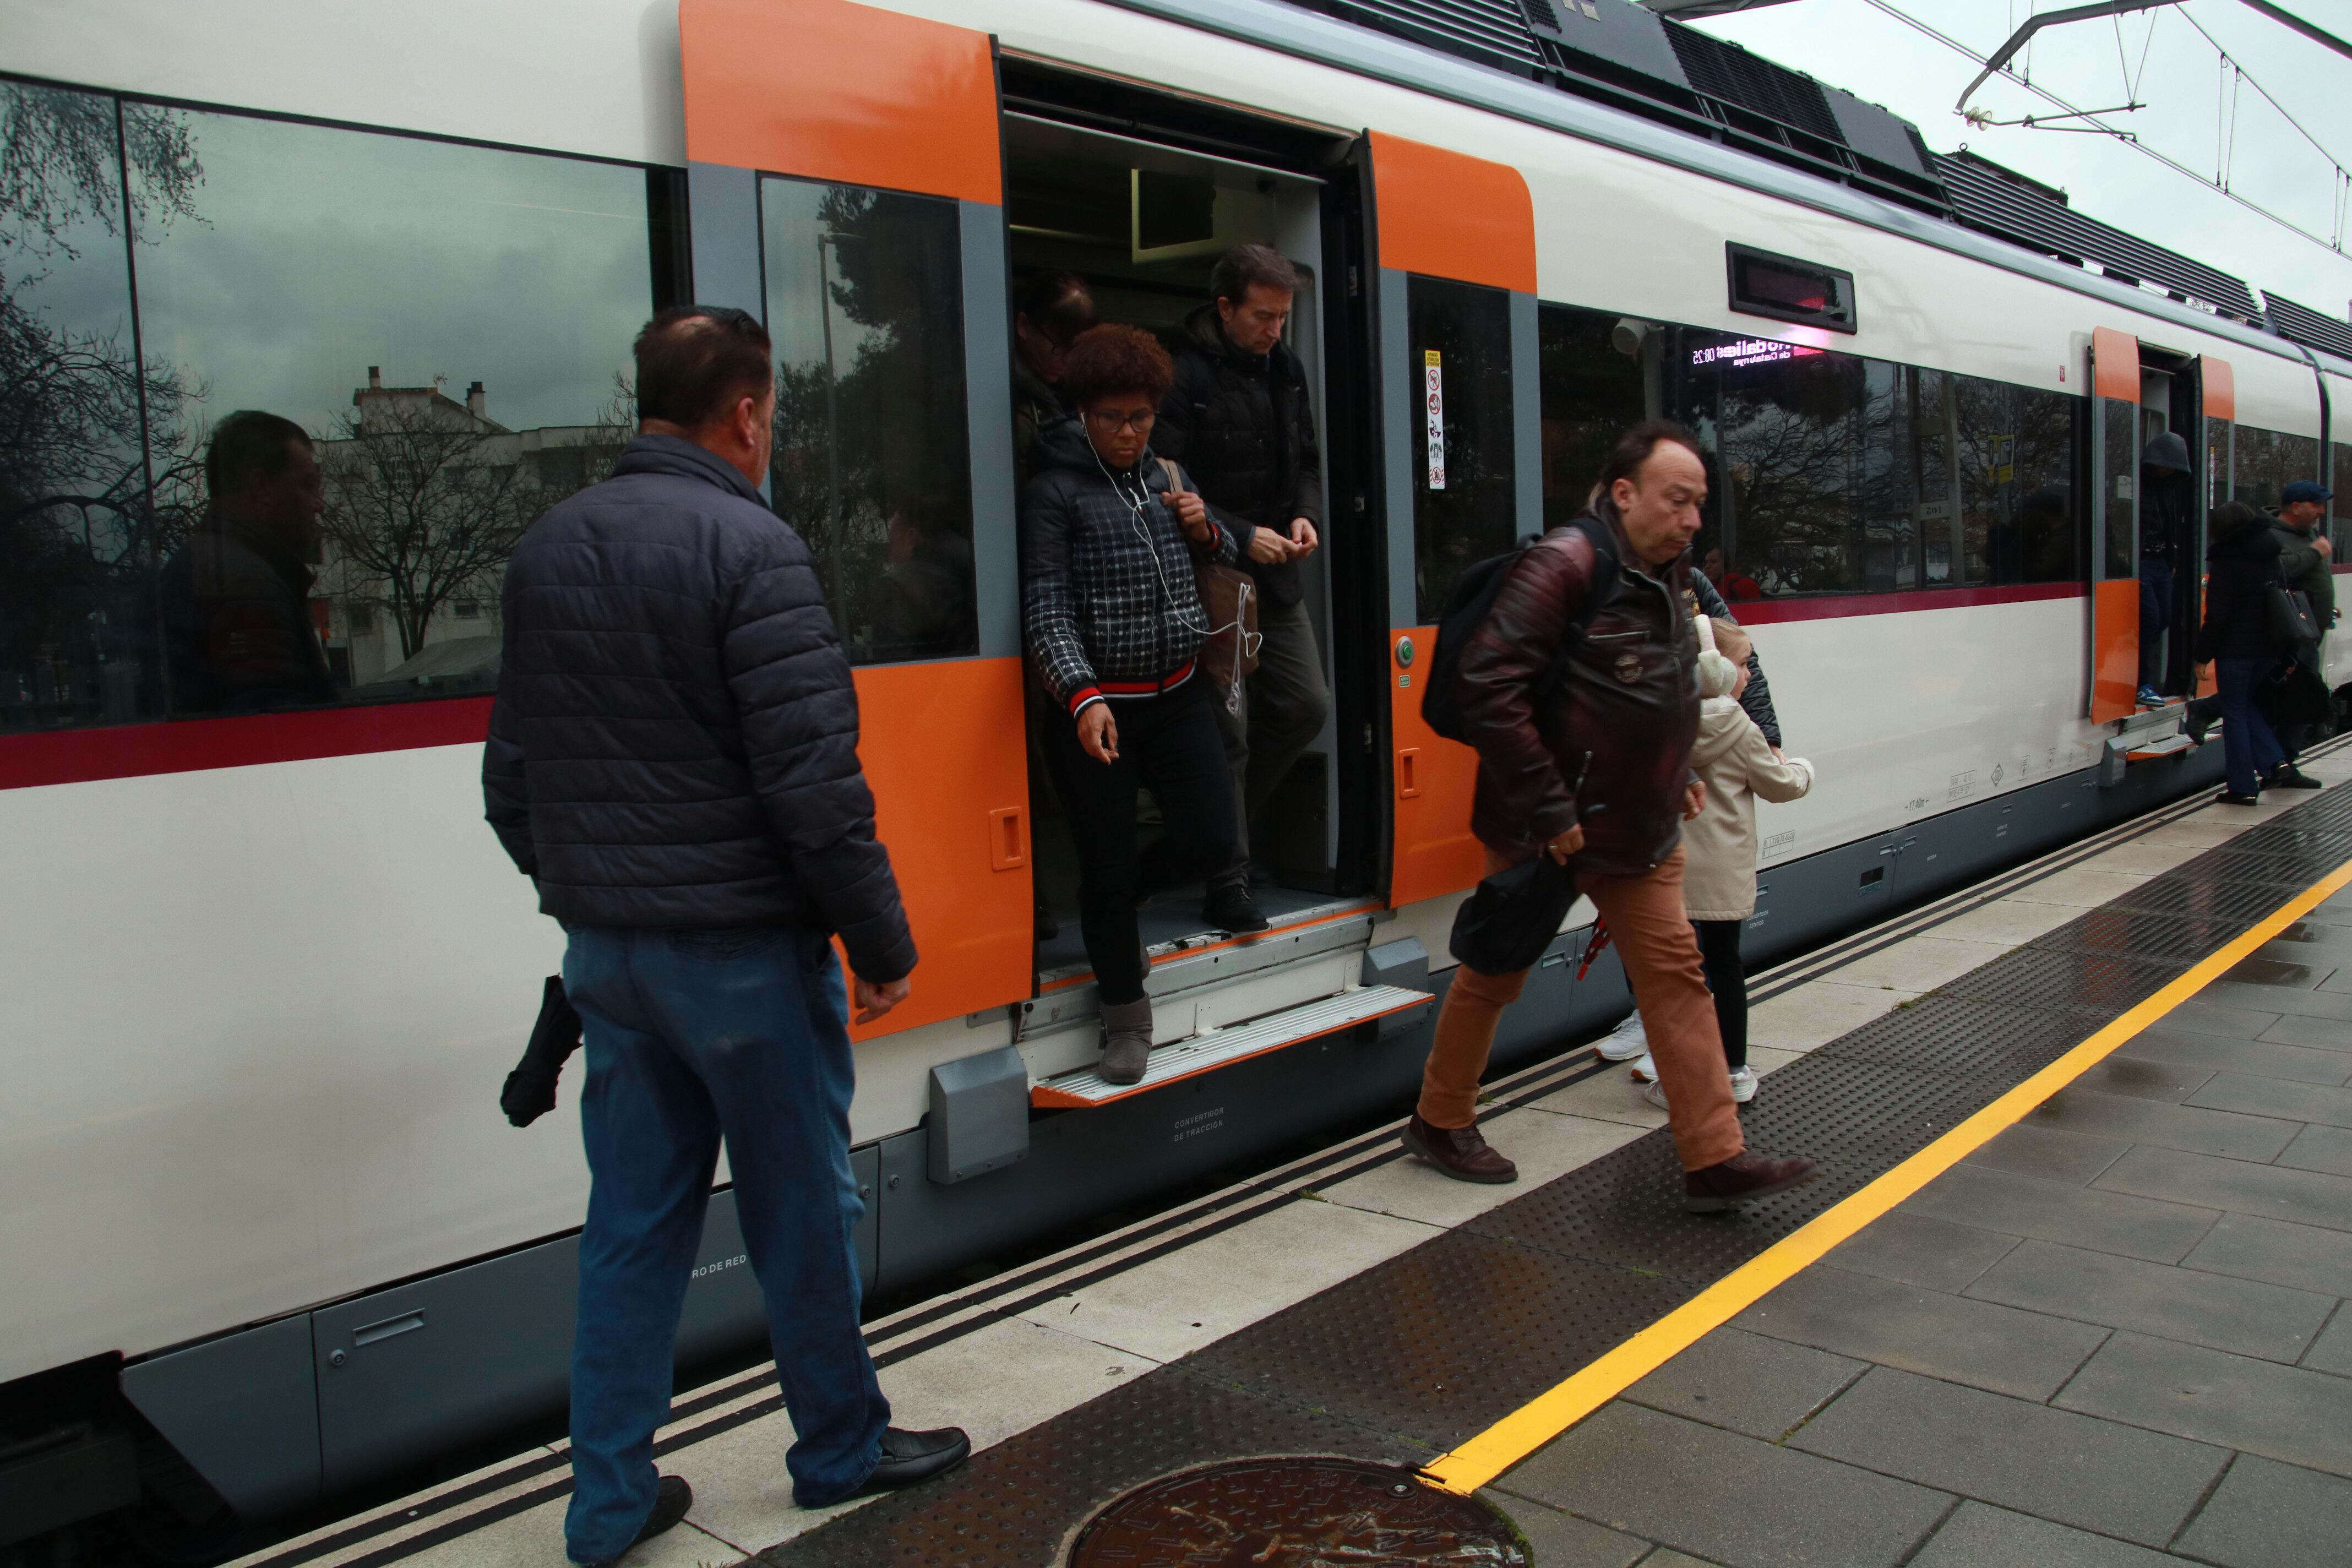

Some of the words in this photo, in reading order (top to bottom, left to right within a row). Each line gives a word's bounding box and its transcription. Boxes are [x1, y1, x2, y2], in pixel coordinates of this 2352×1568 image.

[1174, 1107, 1224, 1129] CONVERTIDOR
[1174, 1132, 1184, 1142] DE
[1186, 1119, 1223, 1137] TRACCION
[692, 1267, 707, 1279] RO
[709, 1261, 723, 1273] DE
[725, 1254, 747, 1268] RED
